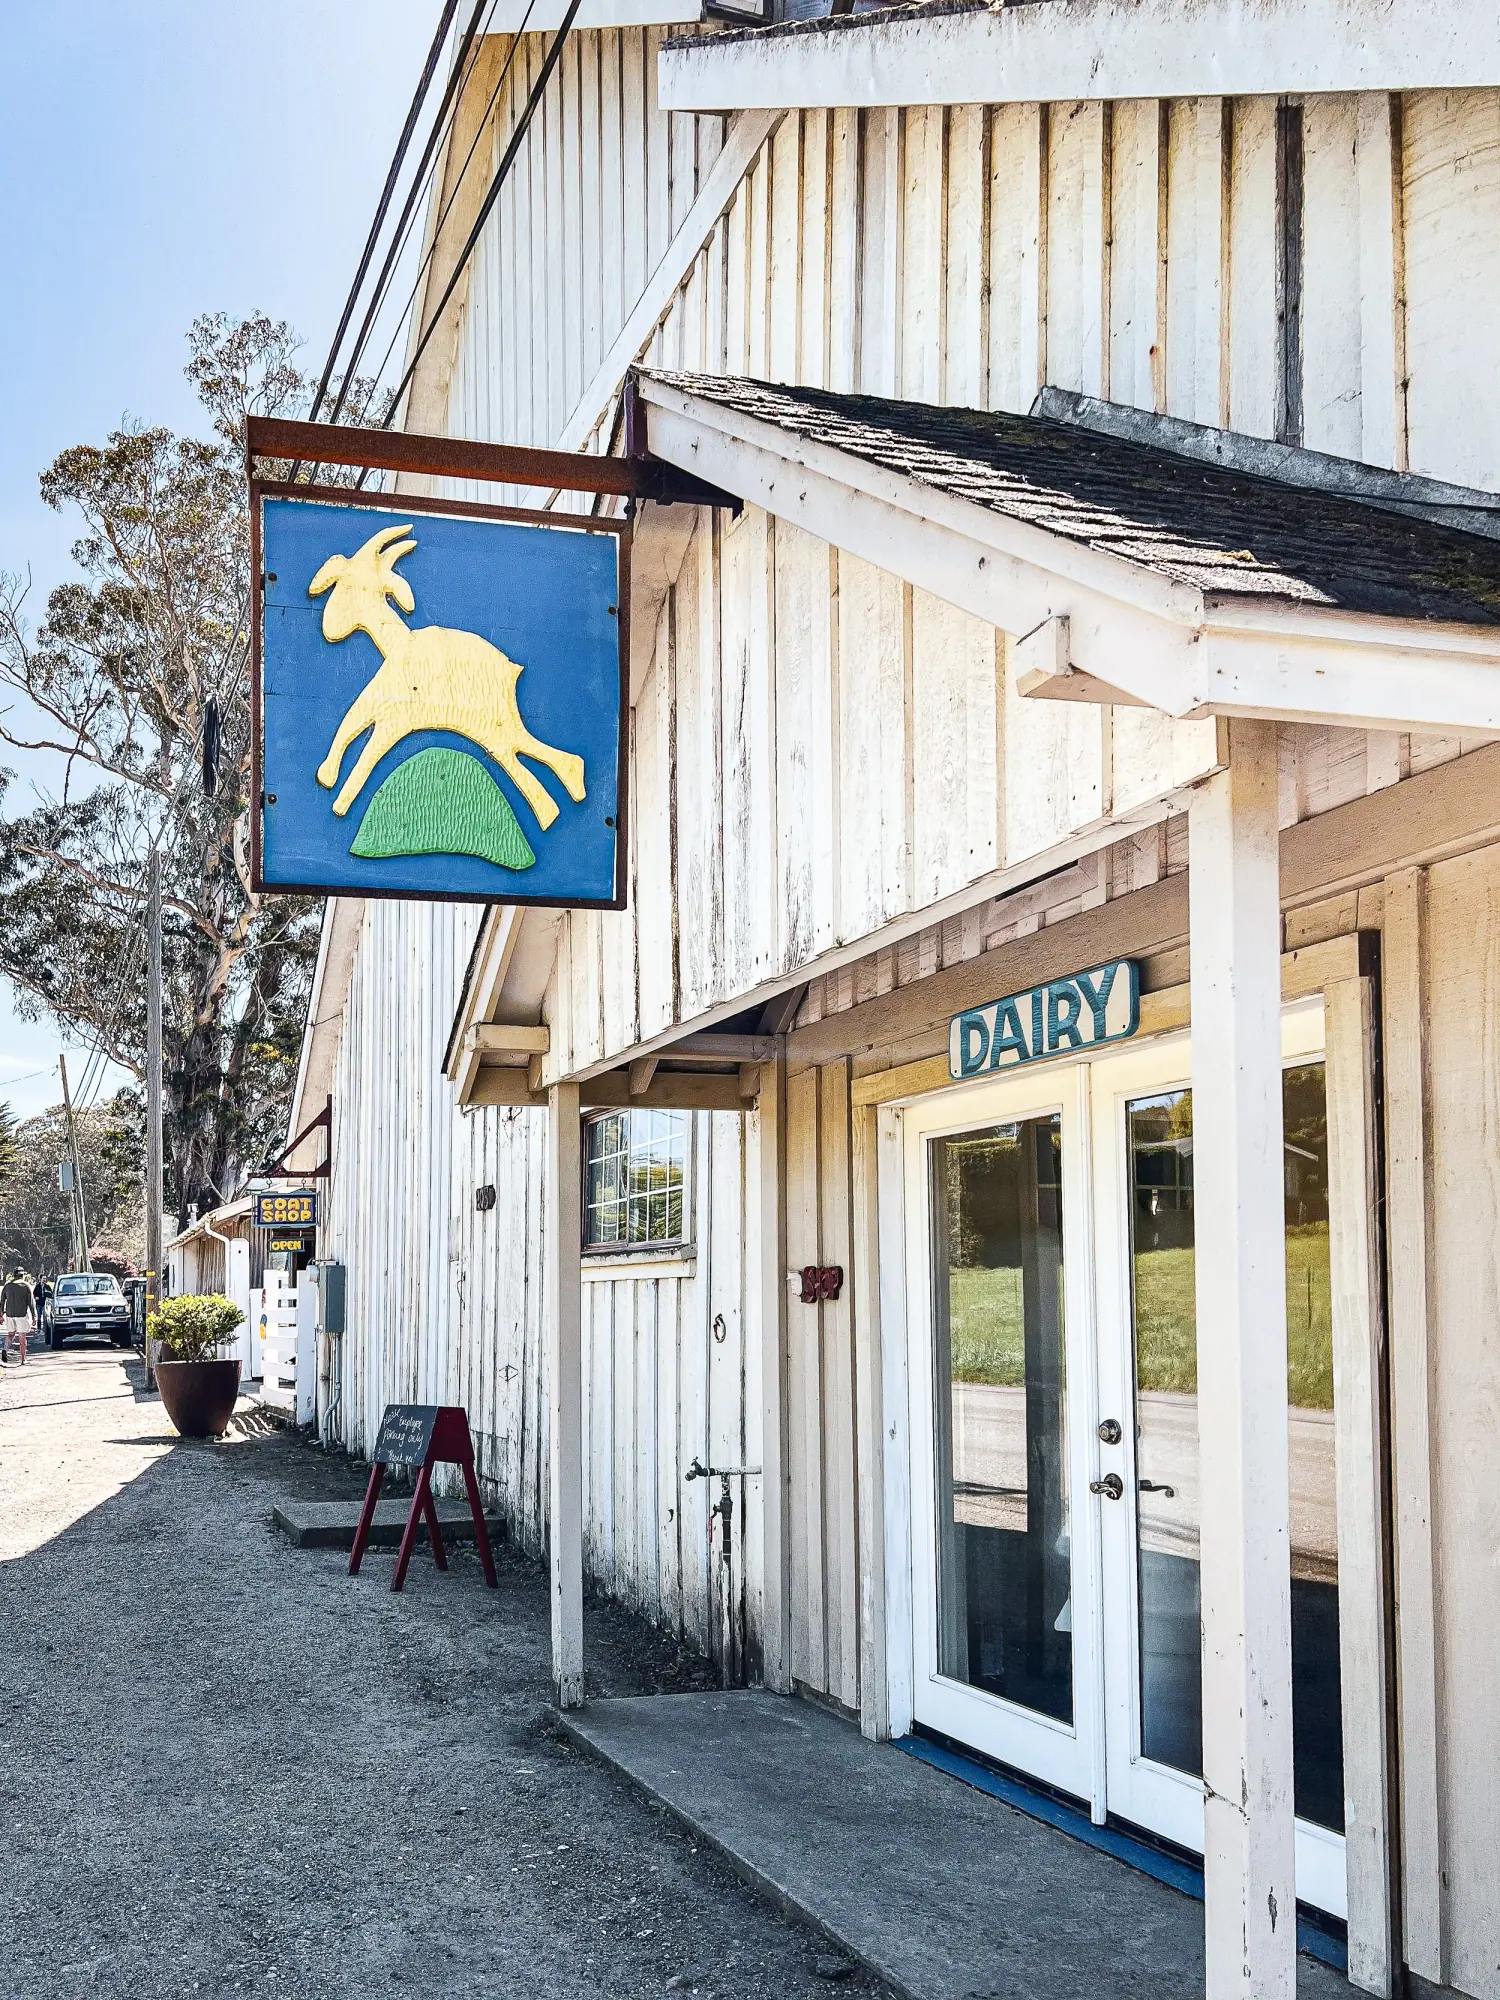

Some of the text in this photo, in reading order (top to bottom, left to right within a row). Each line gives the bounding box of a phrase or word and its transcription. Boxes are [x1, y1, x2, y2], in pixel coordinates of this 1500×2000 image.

[961, 966, 1117, 1076] DAIRY
[260, 1198, 312, 1211] GOAT
[262, 1210, 312, 1223] SHOP
[271, 1240, 302, 1251] OPEN
